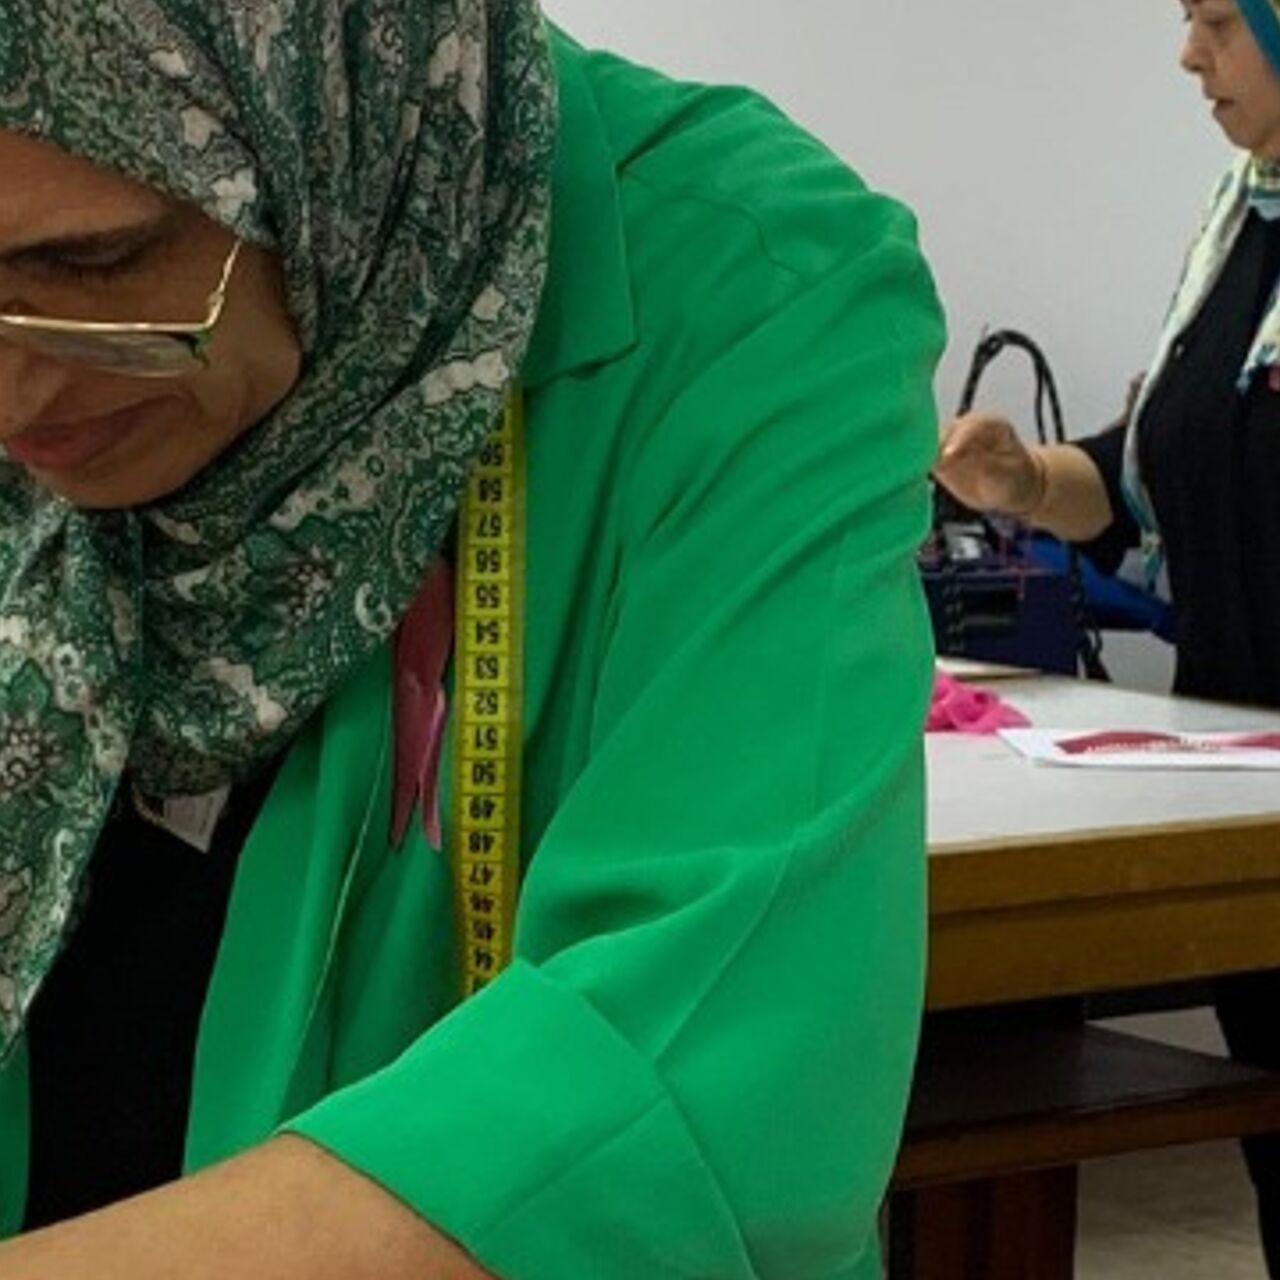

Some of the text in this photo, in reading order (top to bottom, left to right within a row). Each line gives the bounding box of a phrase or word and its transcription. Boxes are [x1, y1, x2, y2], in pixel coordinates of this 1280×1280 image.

[477, 515, 502, 537] 57
[476, 550, 501, 573] 56
[476, 586, 501, 607] 55
[476, 623, 499, 644] 54
[476, 657, 499, 679] 53
[474, 692, 498, 715] 52
[474, 727, 498, 749] 51
[472, 764, 496, 785] 50
[470, 798, 496, 820] 49
[470, 833, 495, 854] 48
[469, 864, 494, 885] 47
[474, 951, 494, 971] 44
